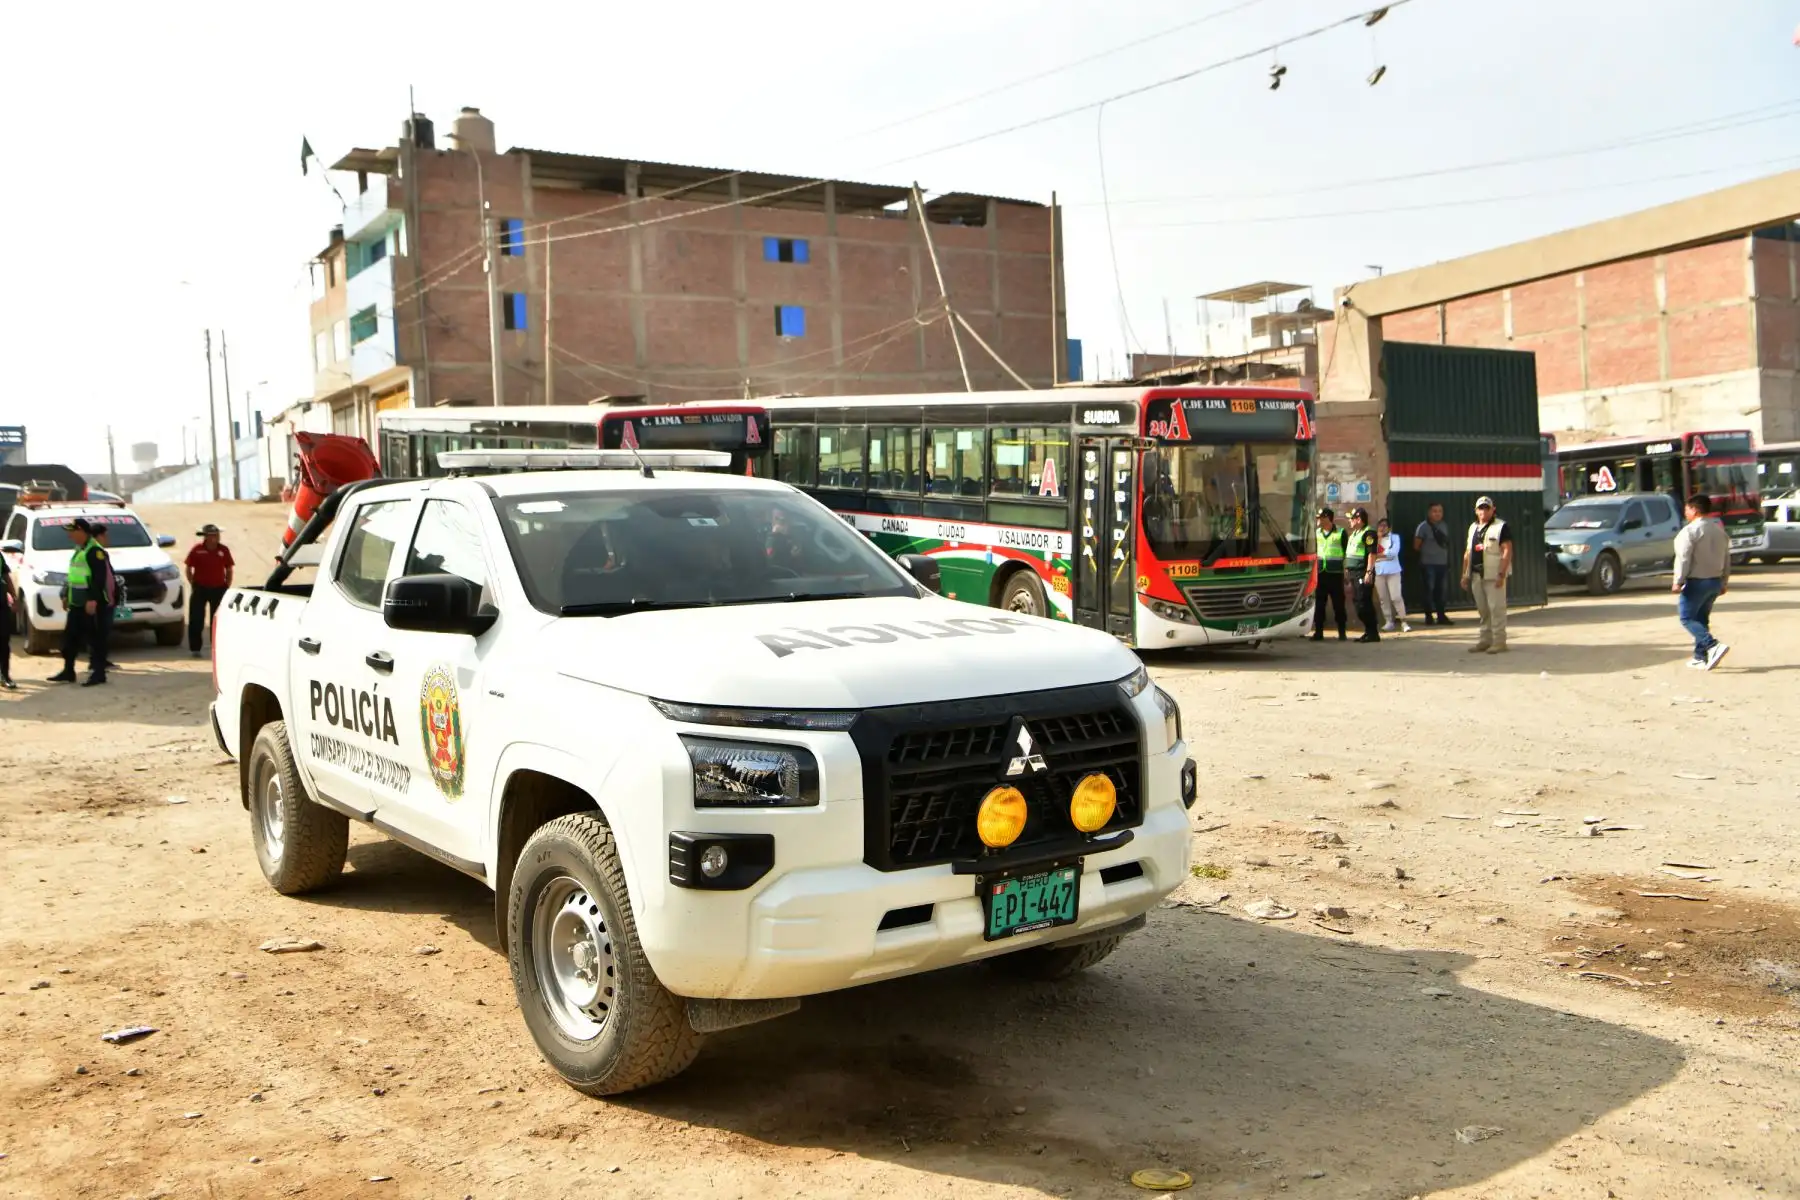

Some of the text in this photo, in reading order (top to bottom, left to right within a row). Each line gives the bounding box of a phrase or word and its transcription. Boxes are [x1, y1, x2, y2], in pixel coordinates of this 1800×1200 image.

[1083, 410, 1120, 424] SUBIDA
[1205, 400, 1227, 409] LIMA
[1232, 402, 1256, 411] 1108
[621, 420, 639, 449] A
[655, 416, 681, 425] LIMA
[746, 415, 761, 444] A
[1690, 434, 1709, 456] A
[1039, 458, 1060, 496] A
[1595, 465, 1617, 492] A
[1083, 451, 1097, 557] SUBIDA
[1113, 452, 1128, 560] SUBIDA
[882, 518, 909, 533] CANADA
[937, 524, 966, 539] CIUDAD
[998, 530, 1049, 548] V.SALVADOR
[1170, 565, 1199, 575] 1108
[310, 679, 399, 746] POLICÍA
[311, 732, 347, 764] COMISARIA
